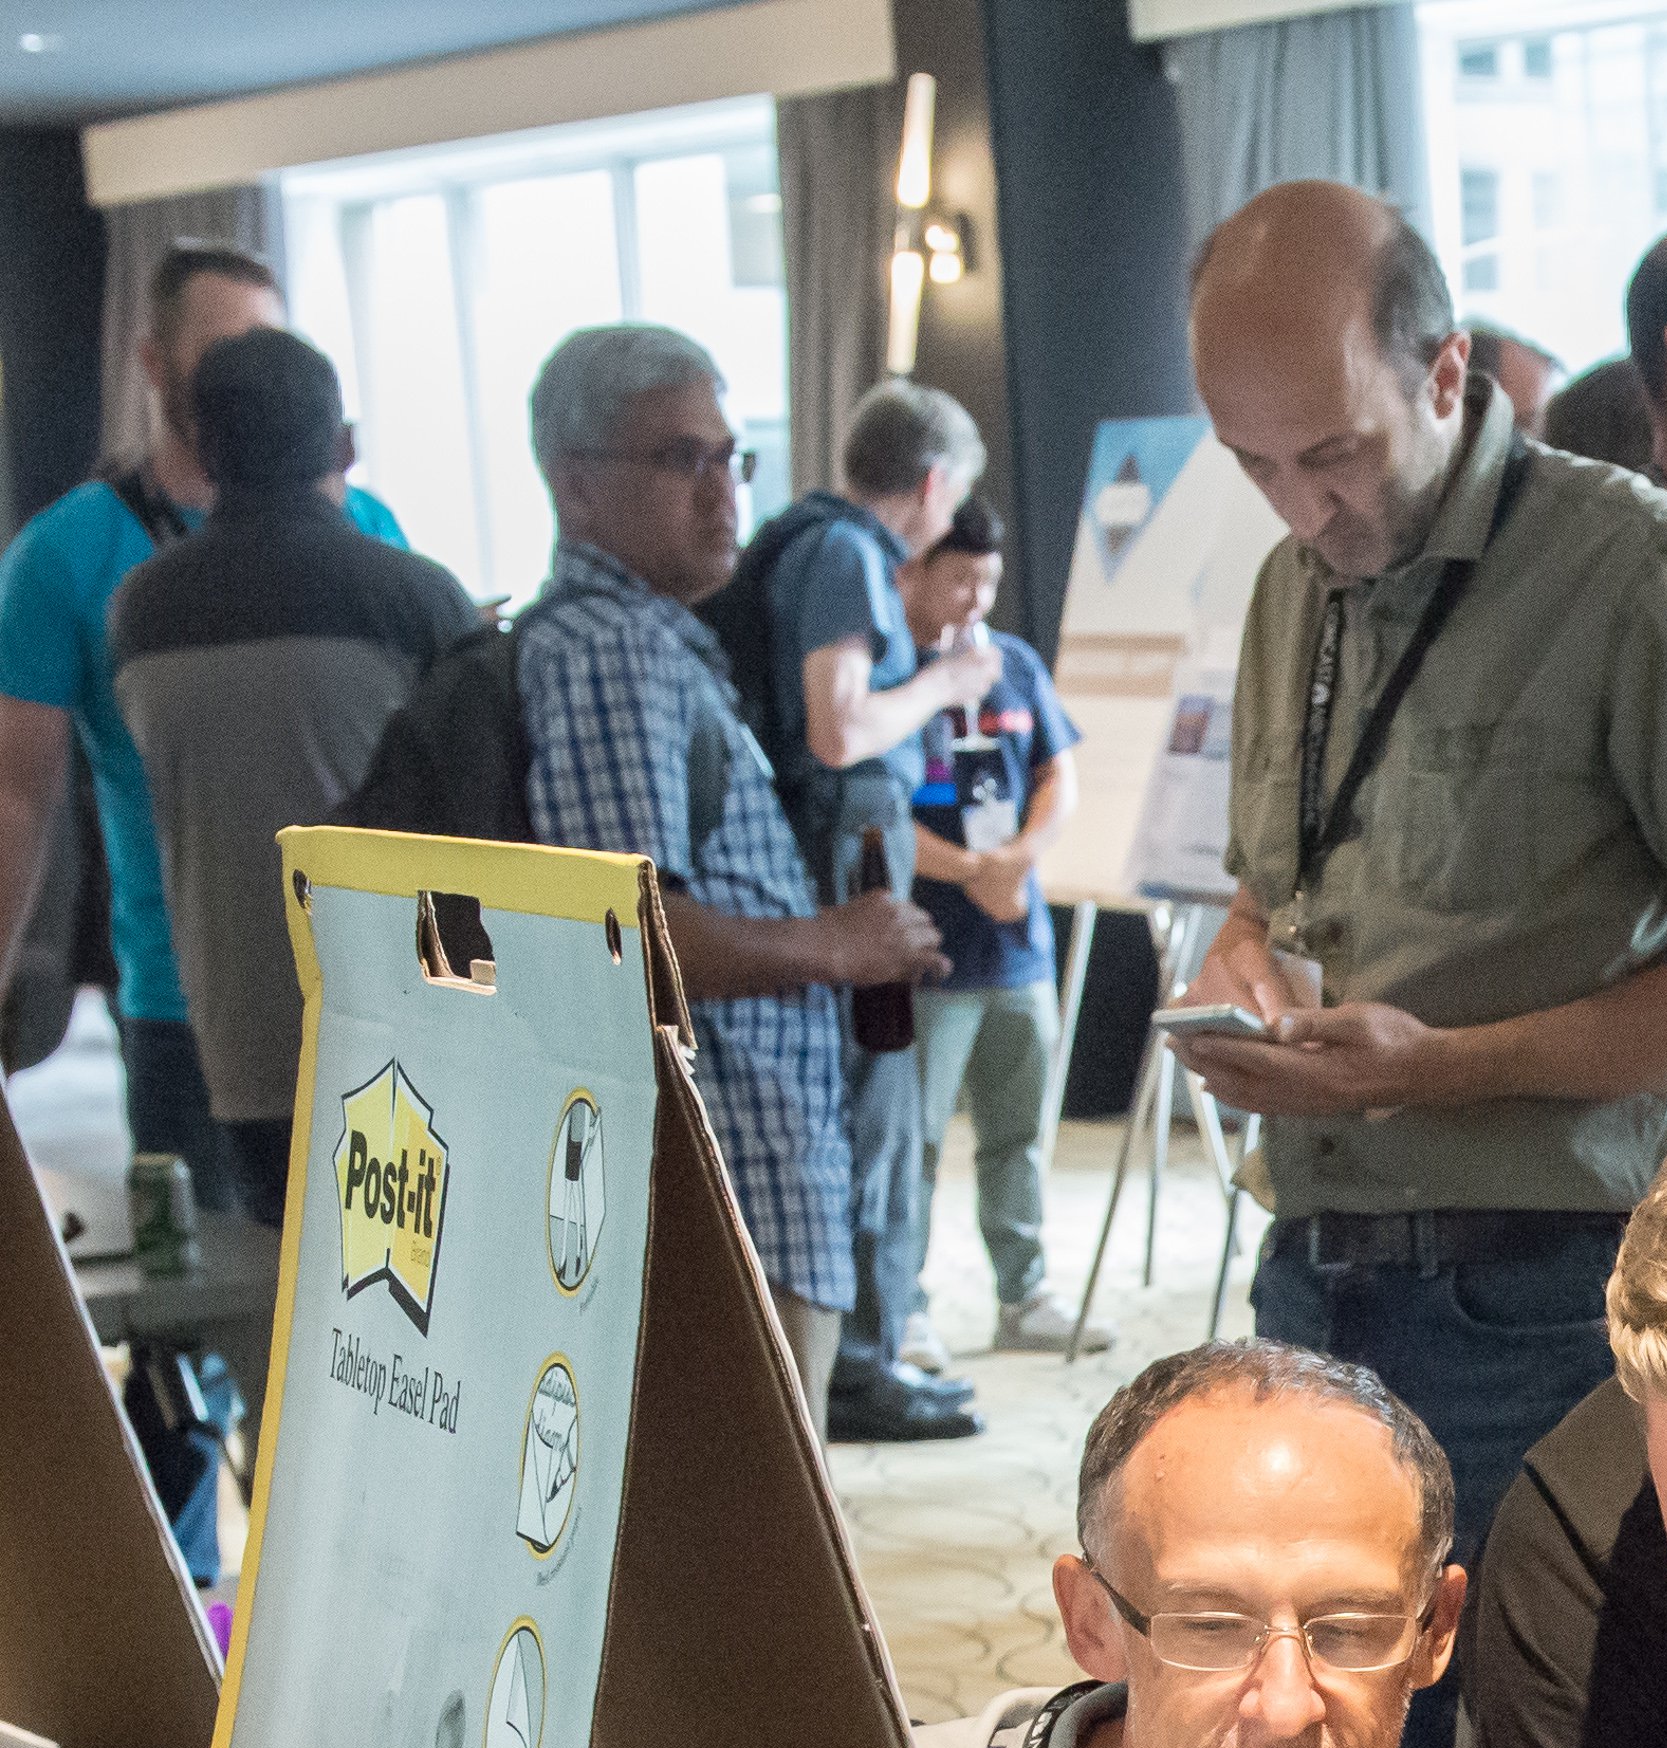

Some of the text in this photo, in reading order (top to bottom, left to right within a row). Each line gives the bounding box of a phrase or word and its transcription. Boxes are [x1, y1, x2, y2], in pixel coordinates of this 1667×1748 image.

[344, 1129, 438, 1239] Post-it
[329, 1328, 388, 1416] Tabletop
[388, 1354, 428, 1416] Easel
[428, 1371, 461, 1435] Pad
